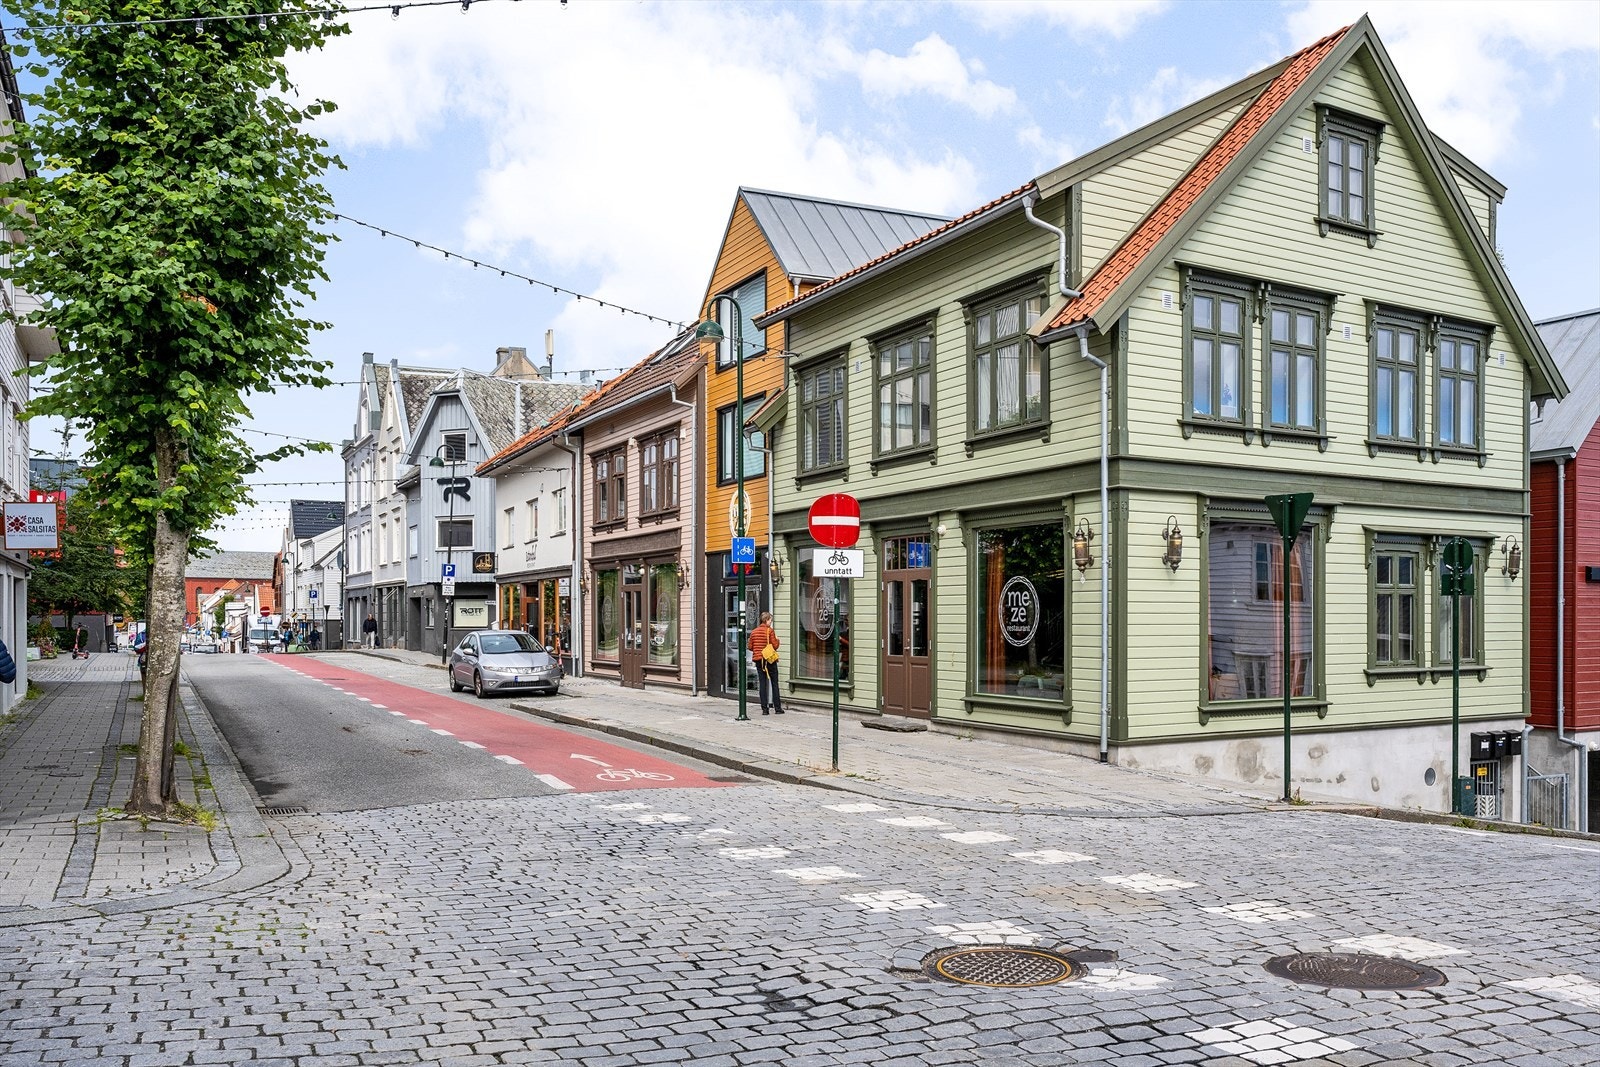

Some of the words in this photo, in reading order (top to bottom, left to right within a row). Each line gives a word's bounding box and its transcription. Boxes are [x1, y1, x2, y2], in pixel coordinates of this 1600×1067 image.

[445, 565, 453, 575] P
[1007, 591, 1032, 606] me
[1010, 607, 1027, 622] ze
